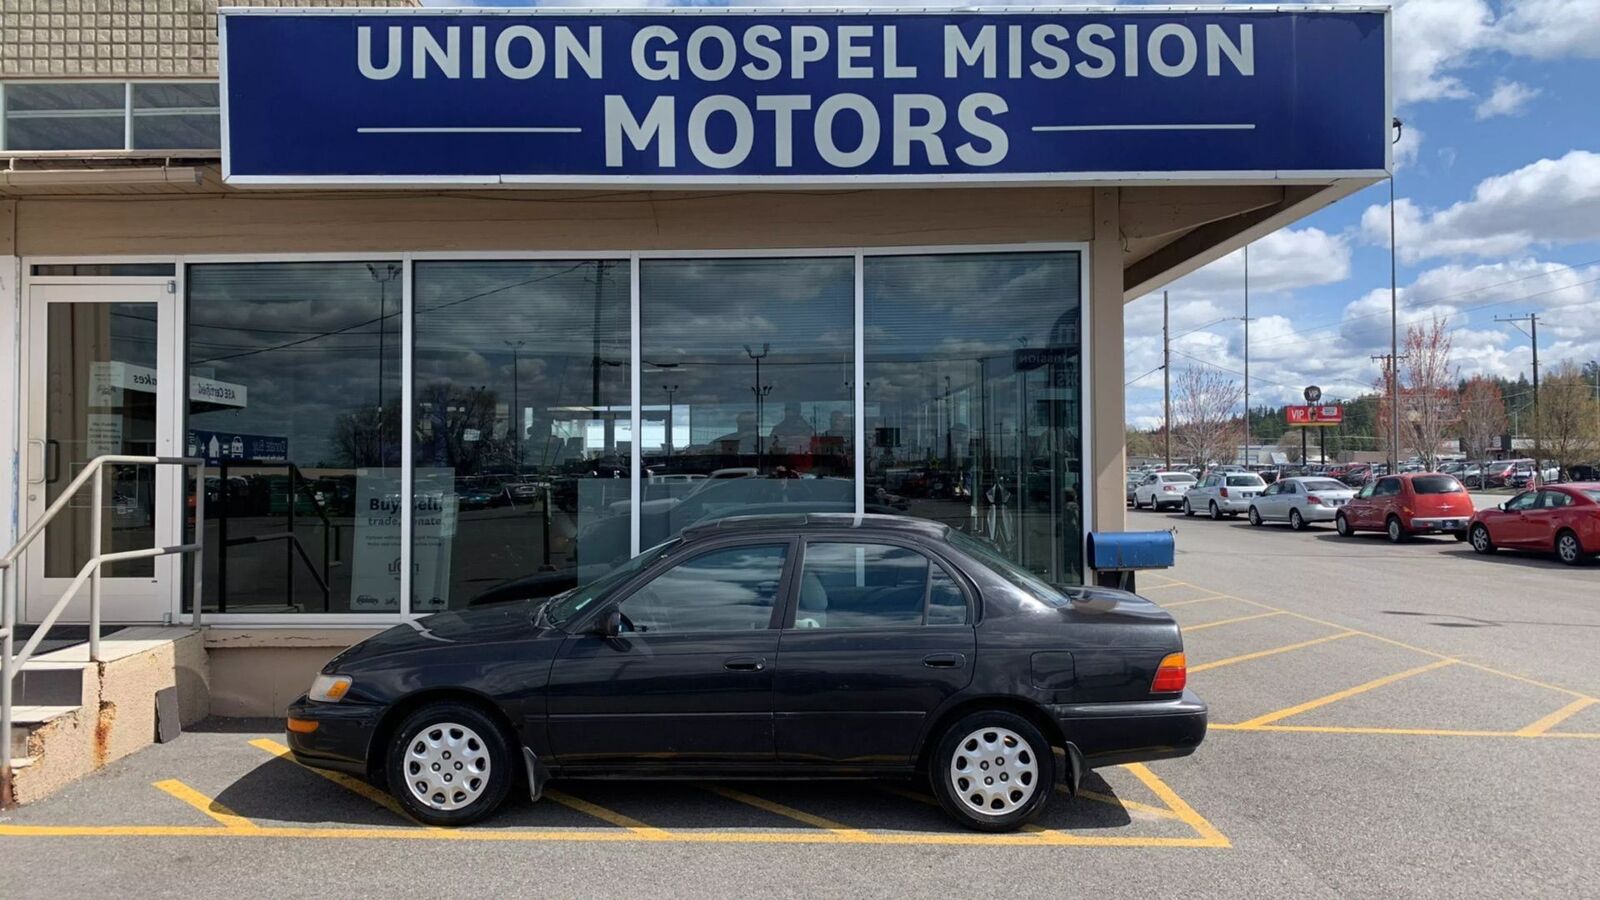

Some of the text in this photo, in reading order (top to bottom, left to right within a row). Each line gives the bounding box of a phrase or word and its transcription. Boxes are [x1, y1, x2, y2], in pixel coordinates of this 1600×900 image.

[357, 24, 1254, 81] UNION GOSPEL MISSION
[604, 92, 1009, 169] MOTORS
[1291, 409, 1304, 420] VIP
